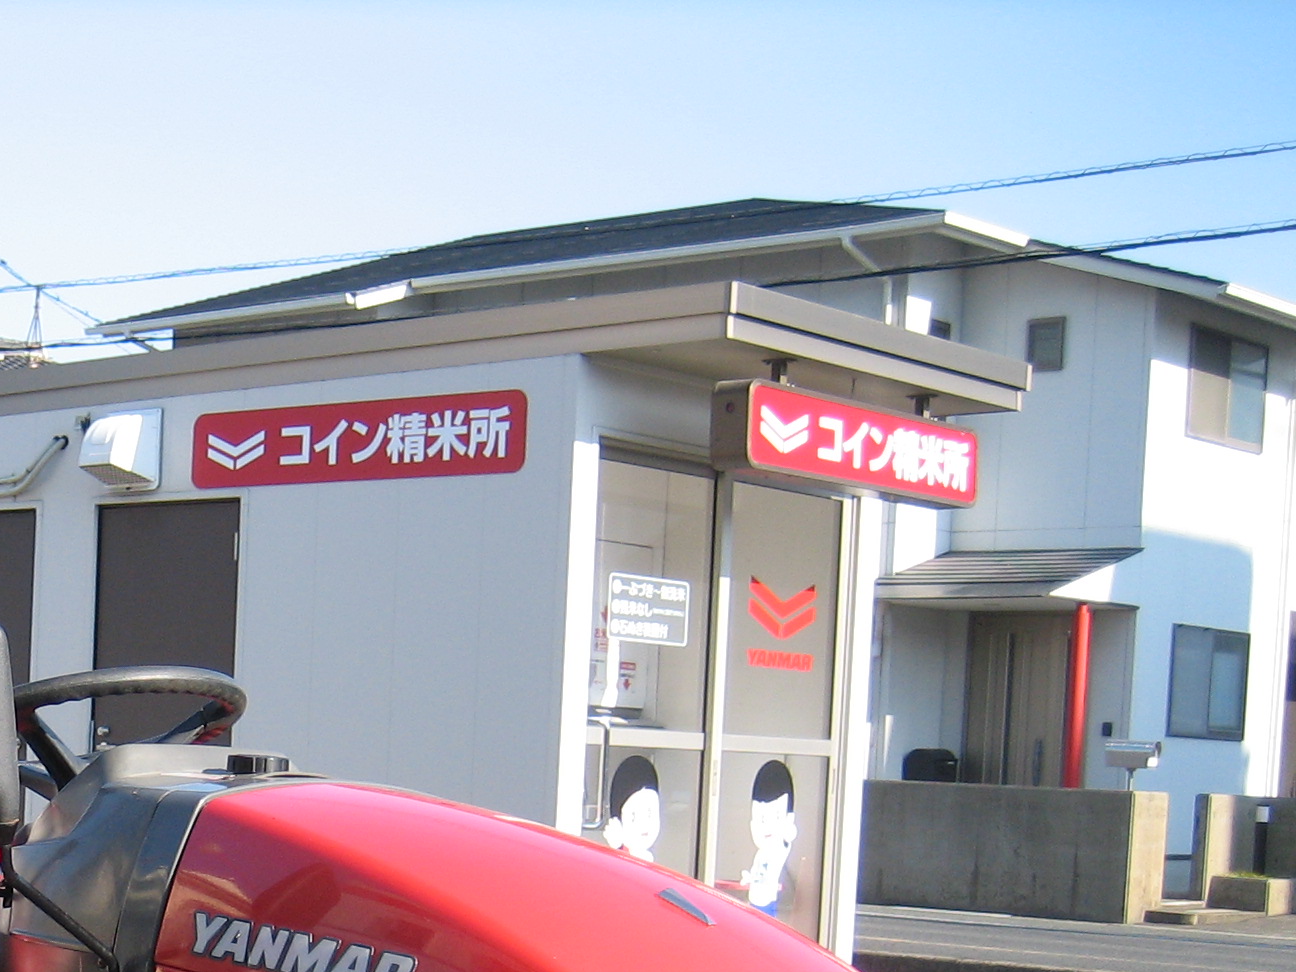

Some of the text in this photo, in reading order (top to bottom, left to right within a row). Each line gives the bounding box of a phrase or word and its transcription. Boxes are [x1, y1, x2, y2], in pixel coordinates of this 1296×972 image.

[279, 405, 512, 466] コイン精米所
[817, 416, 970, 493] コイン精米所
[747, 648, 814, 672] YANMAR
